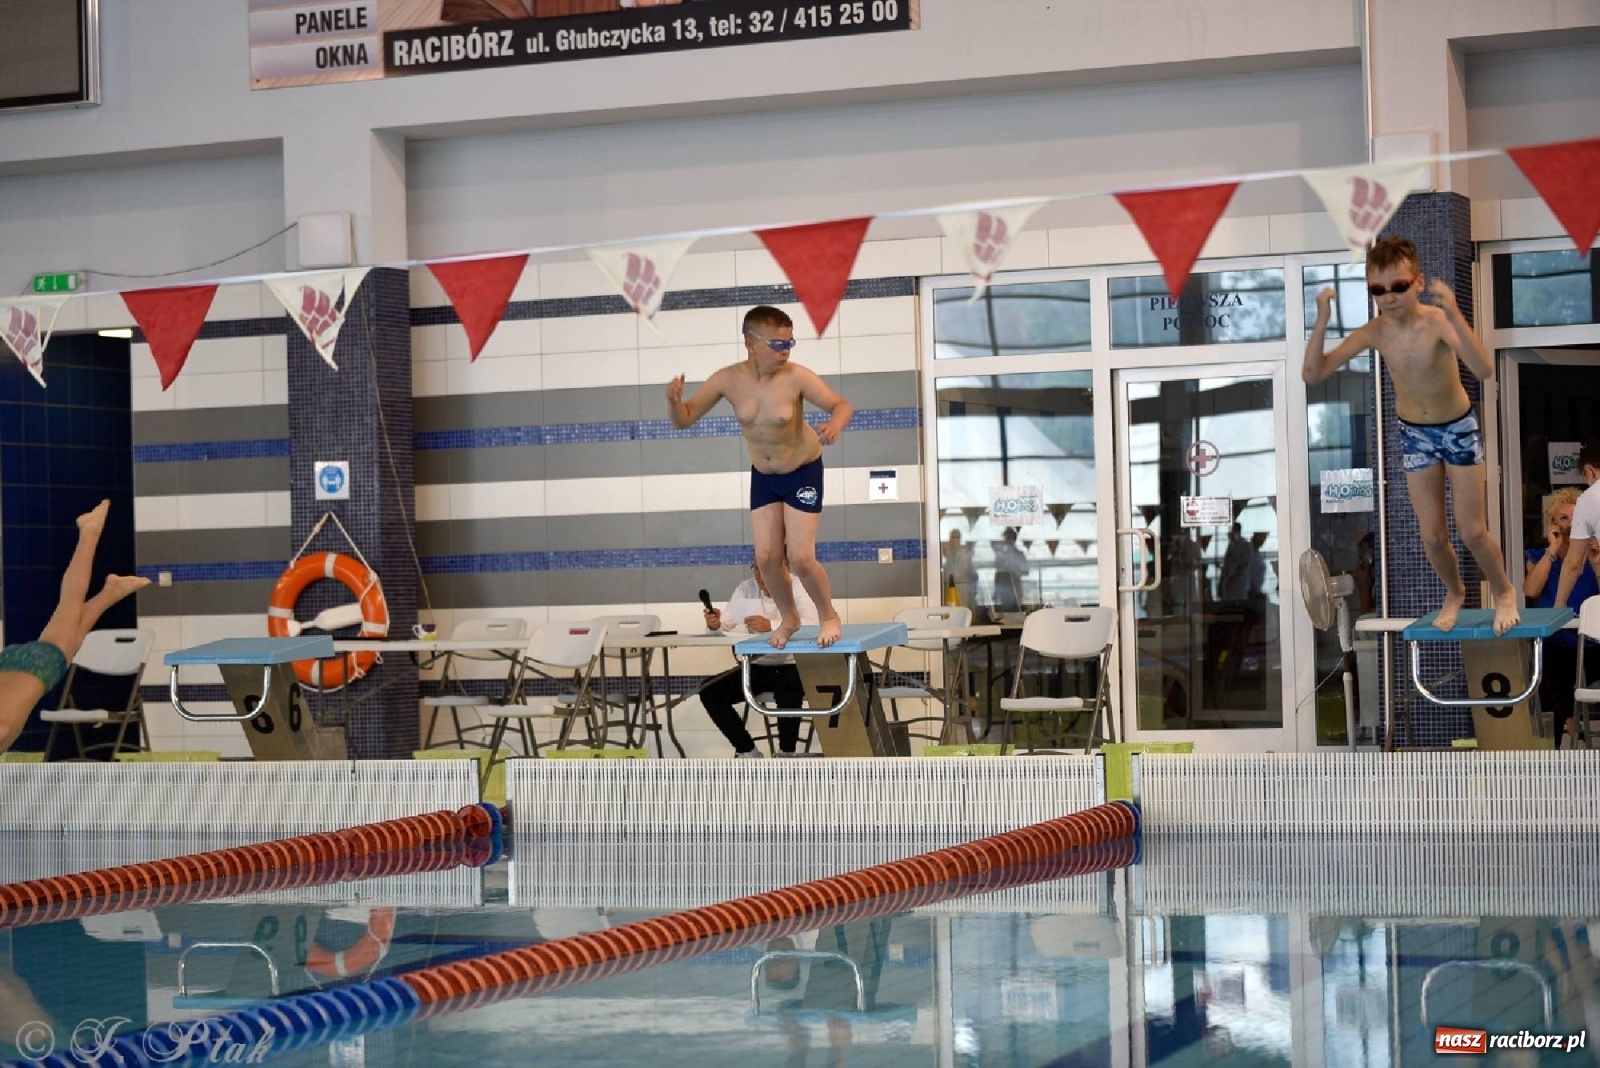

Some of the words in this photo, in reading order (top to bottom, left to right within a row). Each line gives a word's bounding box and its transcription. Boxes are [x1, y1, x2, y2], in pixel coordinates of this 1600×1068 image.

[295, 6, 368, 35] PANELE
[393, 26, 515, 67] RACIBÓRZ
[526, 38, 550, 54] ul.
[556, 22, 666, 52] Głubczycka
[672, 17, 704, 42] 13,
[709, 16, 742, 37] tel:
[749, 12, 775, 34] 32
[779, 8, 788, 33] /
[794, 4, 832, 29] 415
[839, 2, 865, 25] 25
[872, 0, 898, 22] 00
[315, 42, 369, 69] OKNA
[289, 682, 302, 733] 6
[815, 685, 843, 728] 7
